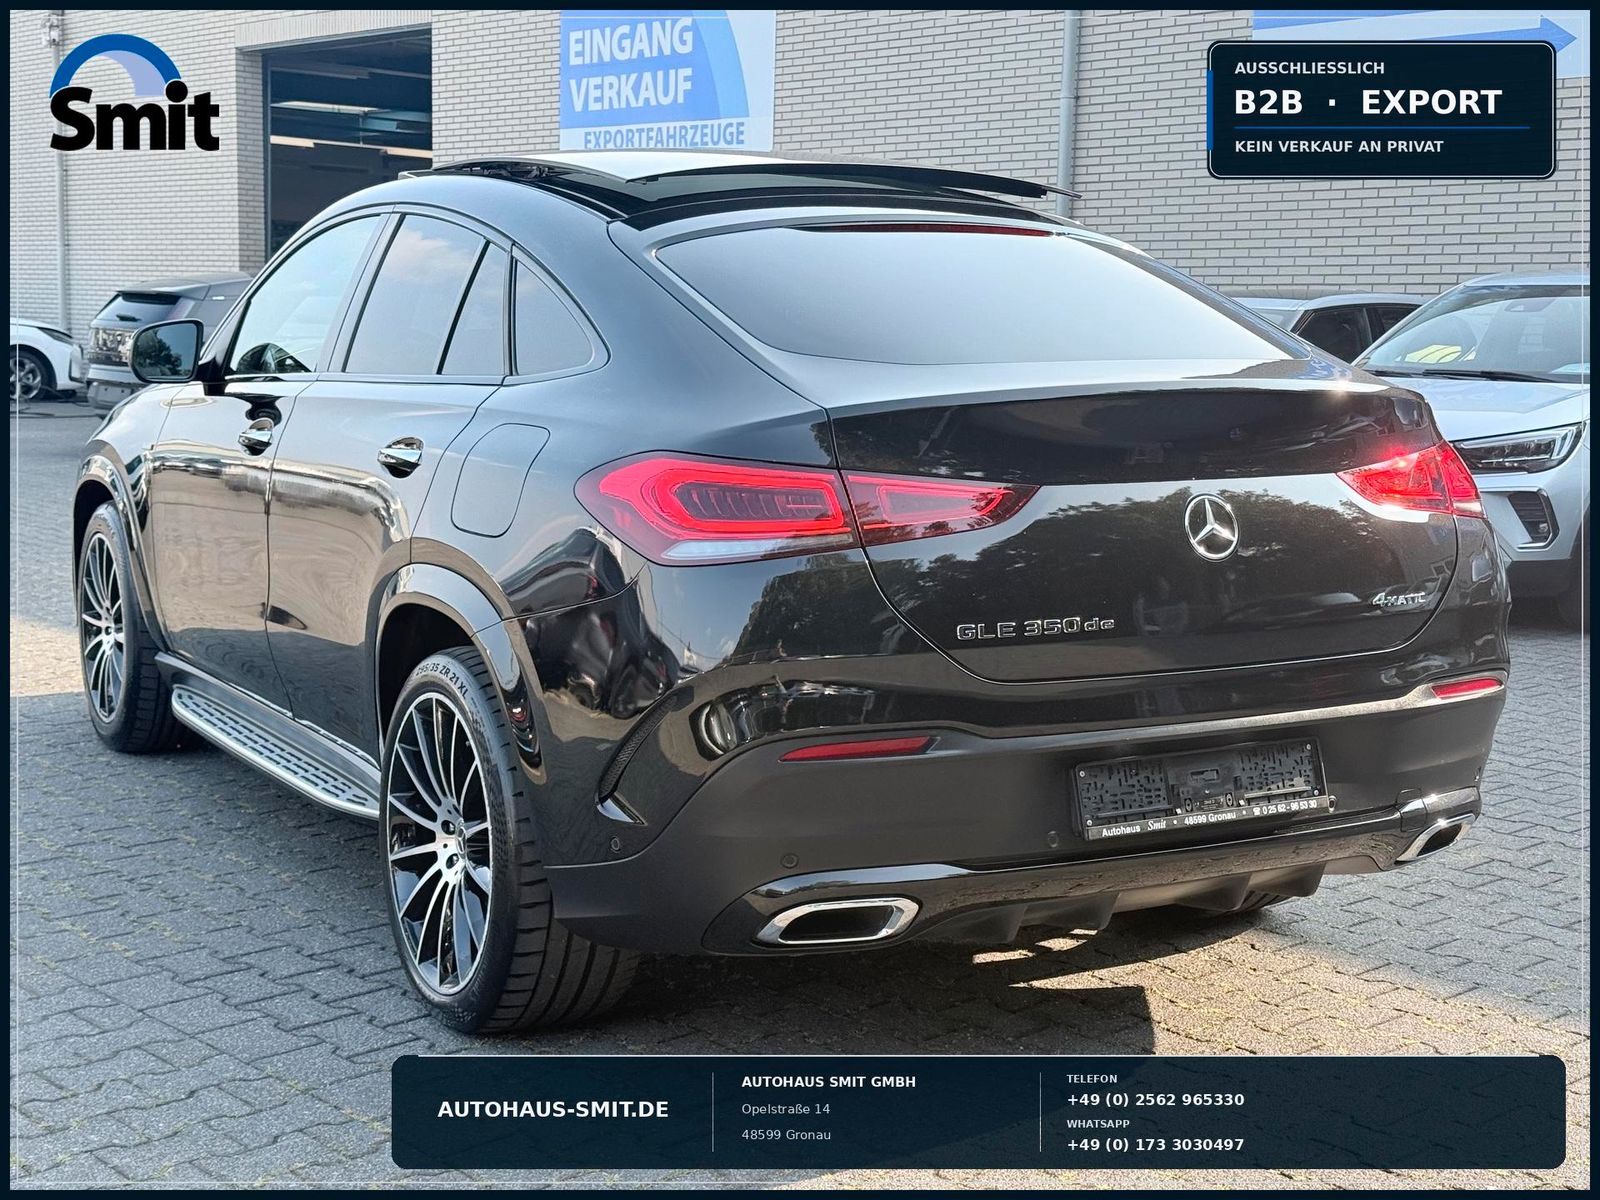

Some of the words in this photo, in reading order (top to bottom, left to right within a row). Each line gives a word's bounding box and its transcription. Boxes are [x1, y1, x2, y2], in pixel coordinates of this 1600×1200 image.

[568, 16, 694, 66] EINGANG
[568, 67, 693, 113] VERKAUF
[583, 121, 745, 149] EXPORTFAHRZEUGE
[956, 622, 1016, 641] GLE
[439, 665, 451, 678] ZR
[449, 672, 459, 686] 21
[457, 681, 469, 700] XL
[1101, 824, 1141, 838] Autohaus
[1147, 819, 1167, 832] Smit
[1183, 816, 1207, 826] 48599
[1207, 811, 1237, 823] Gronau
